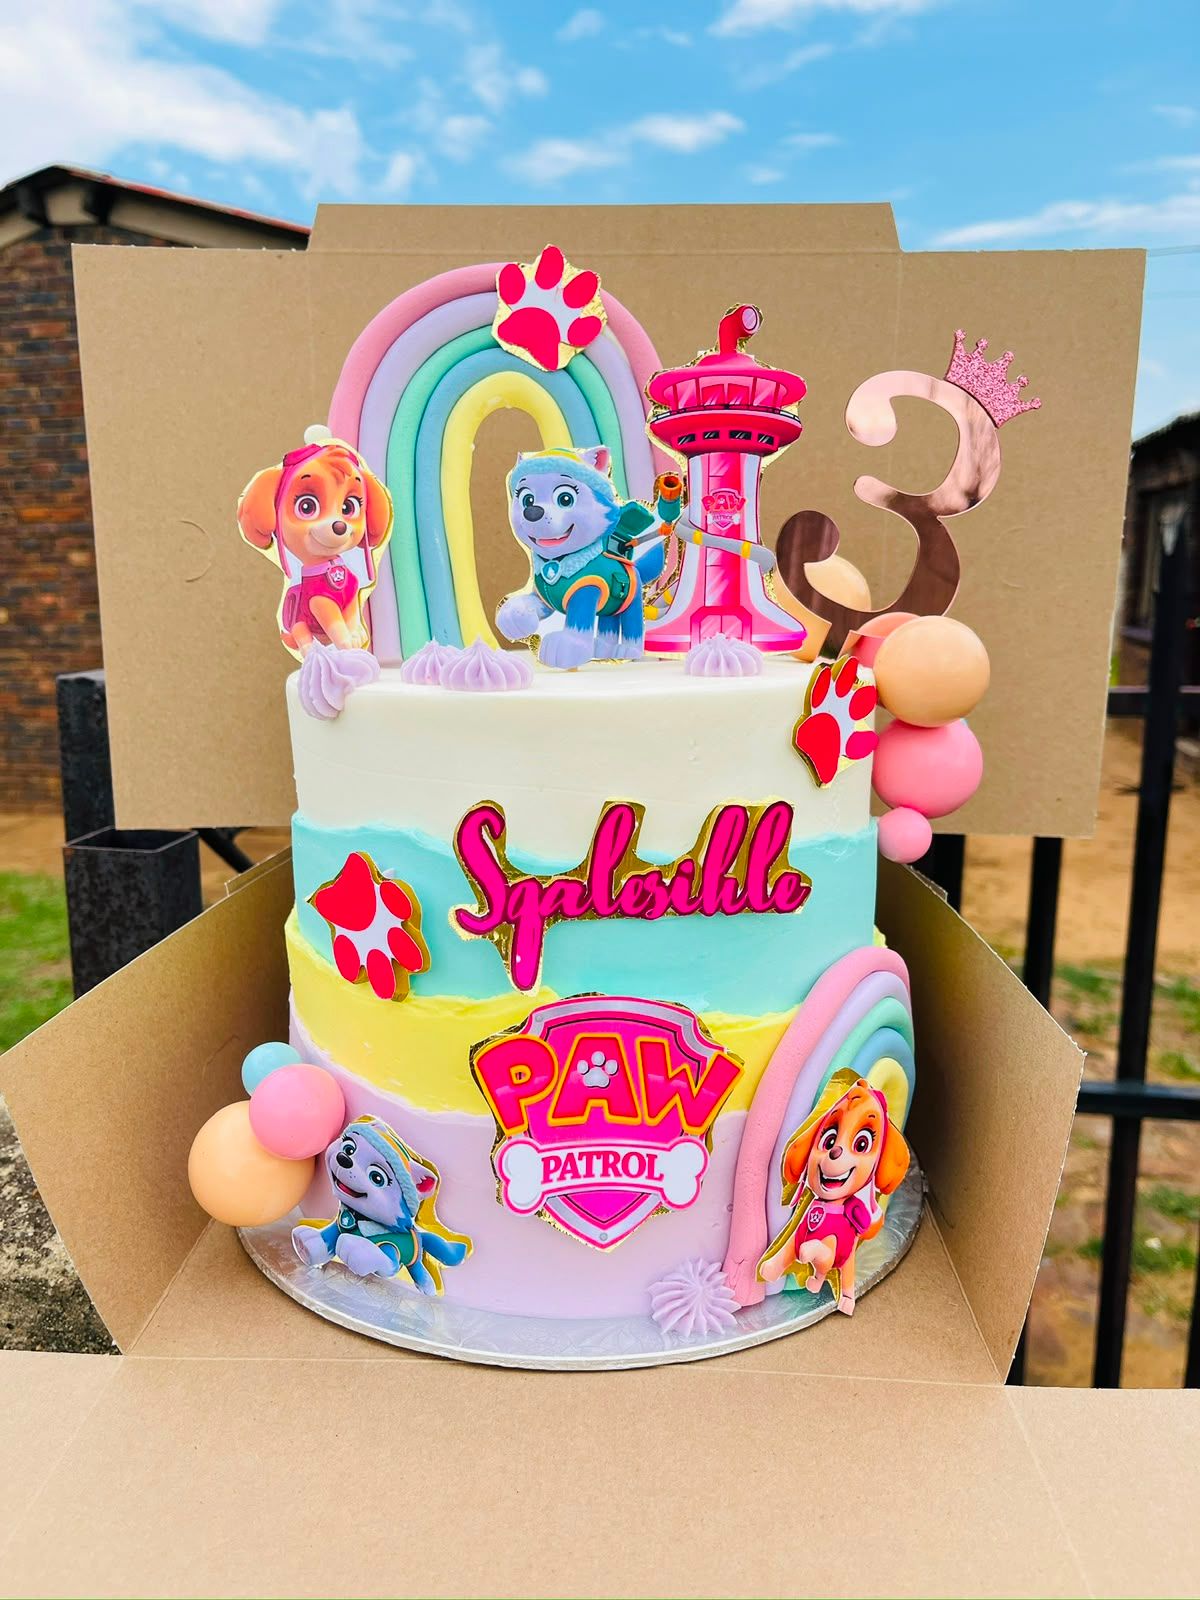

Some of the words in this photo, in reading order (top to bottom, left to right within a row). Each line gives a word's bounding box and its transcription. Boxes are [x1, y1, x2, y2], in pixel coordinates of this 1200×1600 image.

[702, 494, 746, 511] PAW
[775, 370, 1001, 628] 3
[455, 801, 811, 991] Sqalesihle
[475, 1033, 744, 1135] PAW
[541, 1150, 664, 1184] PATROL
